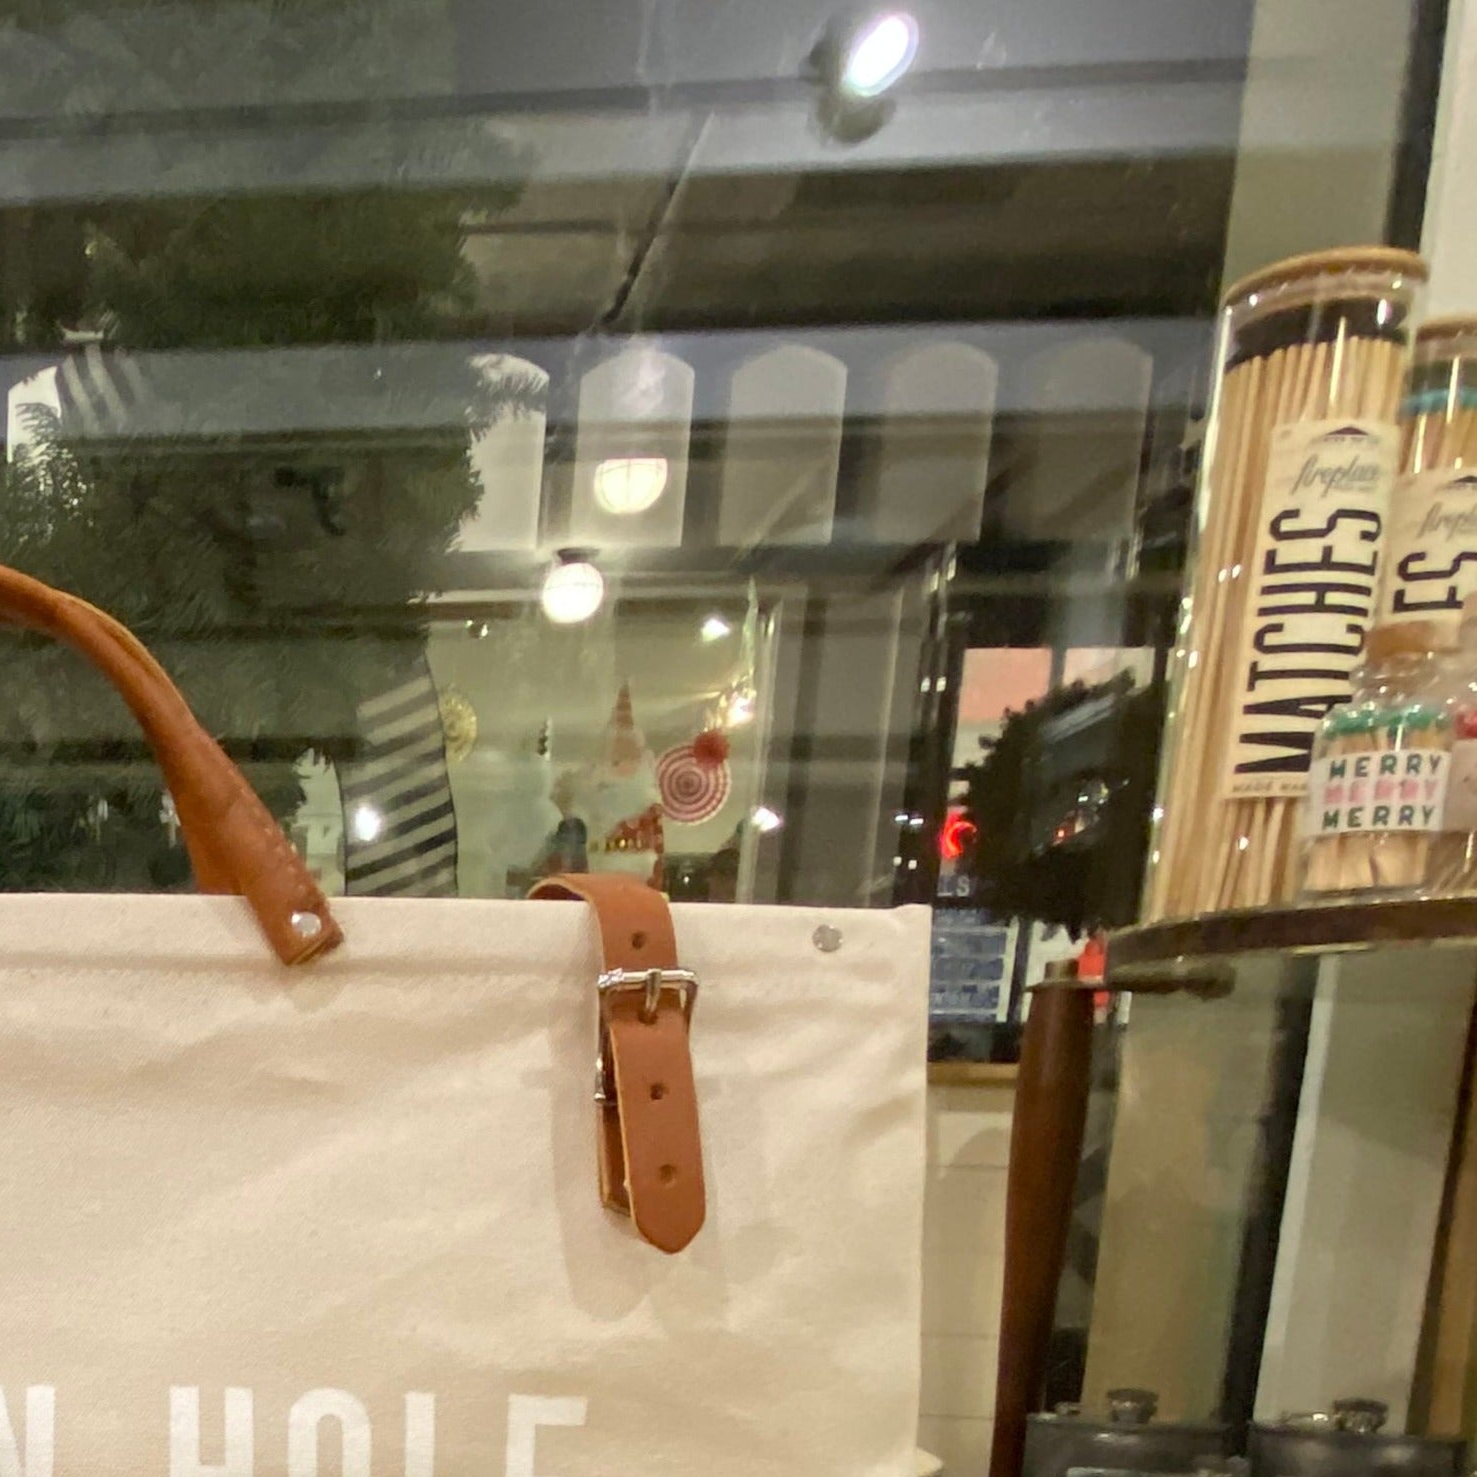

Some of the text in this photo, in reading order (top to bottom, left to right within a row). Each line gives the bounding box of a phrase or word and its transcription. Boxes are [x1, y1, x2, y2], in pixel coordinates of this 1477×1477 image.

[1234, 508, 1382, 775] MATCHES
[1329, 752, 1442, 780] MERRY
[1323, 804, 1436, 829] MERRY
